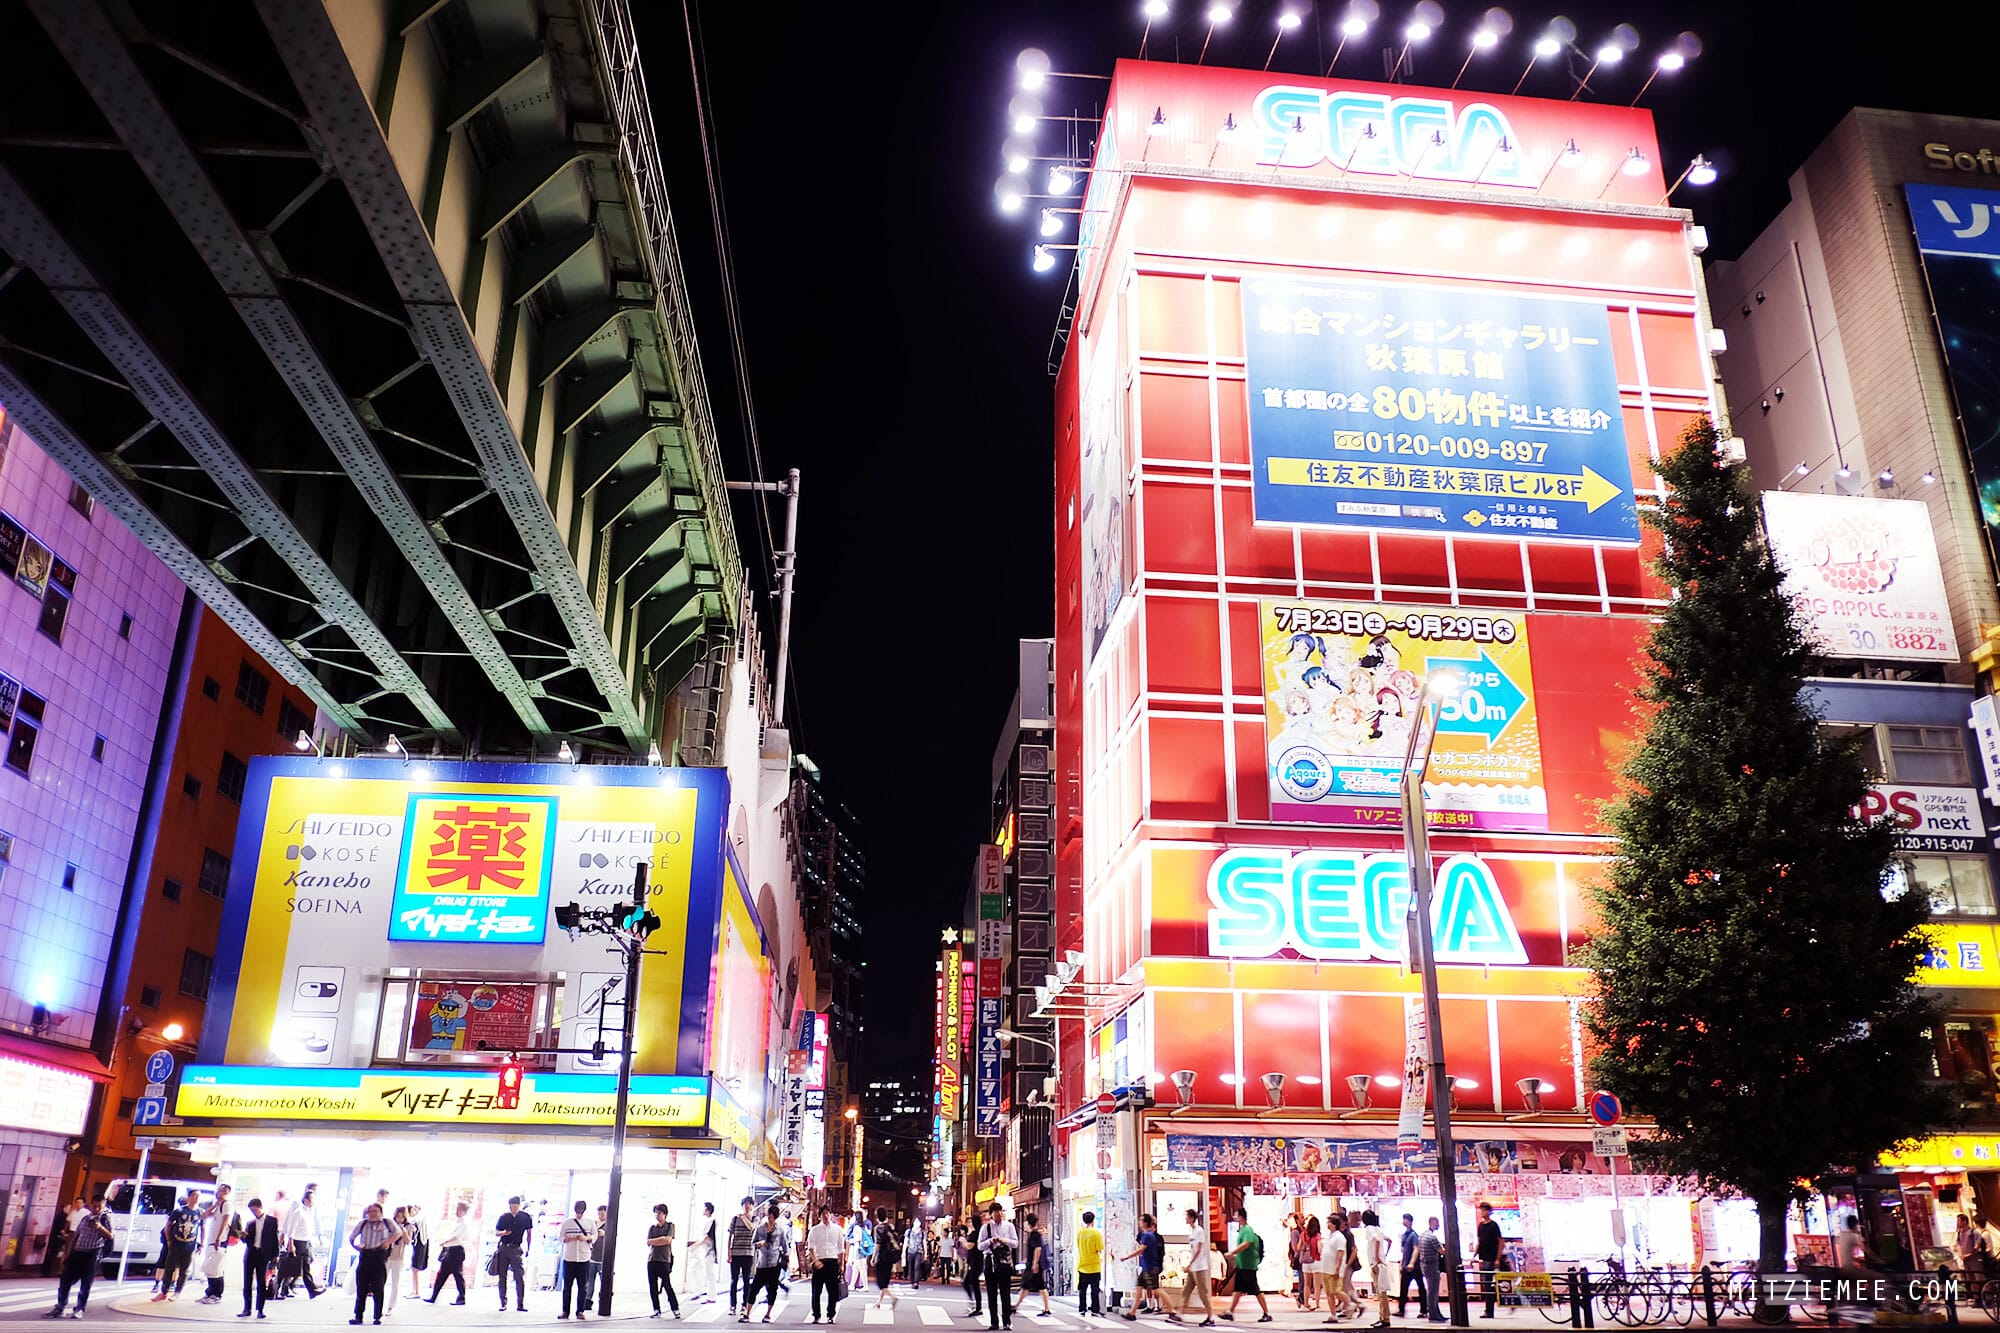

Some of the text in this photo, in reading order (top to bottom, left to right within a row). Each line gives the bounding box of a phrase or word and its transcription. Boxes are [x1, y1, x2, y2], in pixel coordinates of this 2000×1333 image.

[1253, 86, 1536, 188] SEGA
[1932, 199, 2000, 239] ソ
[1366, 431, 1549, 464] 0120-009-897
[1306, 462, 1584, 498] 住友不動産秋葉原ビル8F
[1489, 514, 1559, 531] 住友不動産
[1848, 790, 1922, 829] PS
[278, 819, 392, 837] SHISEIDO
[1927, 816, 1971, 830] next
[569, 827, 681, 845] SHISEIDO
[1894, 838, 1974, 851] 120-915-047
[322, 846, 380, 862] KOSÉ
[426, 805, 531, 891] 薬
[283, 870, 372, 890] Kanebo
[578, 878, 664, 896] Kaneo
[285, 897, 363, 915] SOFINA
[433, 896, 509, 907] DRUG STORE
[1207, 848, 1530, 964] SEGA
[151, 1058, 163, 1078] P
[981, 1000, 997, 1123] ホビーステーション
[204, 1095, 357, 1110] Matsumoto KiYoshi
[381, 1087, 505, 1115] マツモトキヨ
[532, 1101, 682, 1117] Matsumoto KiYoshi
[142, 1101, 160, 1125] P
[1975, 1143, 2000, 1160] 松
